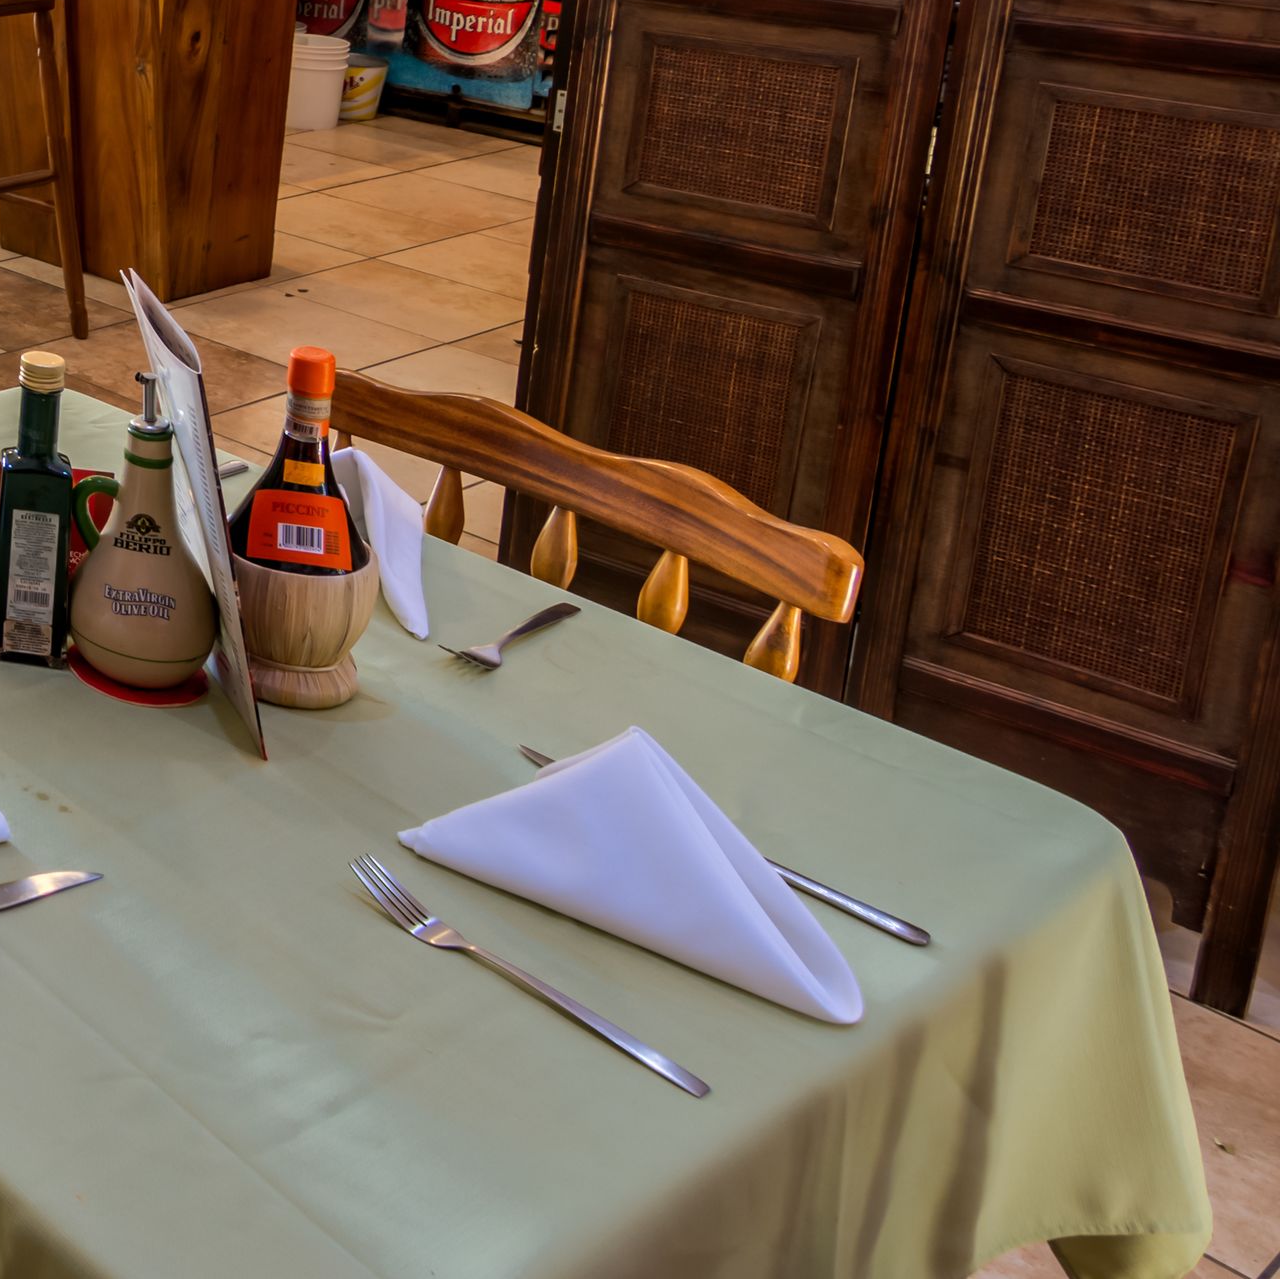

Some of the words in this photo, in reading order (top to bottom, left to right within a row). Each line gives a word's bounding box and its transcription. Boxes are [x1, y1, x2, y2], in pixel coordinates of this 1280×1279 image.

[271, 500, 329, 519] PICCINI
[113, 537, 173, 557] BERIO
[120, 532, 167, 546] FILIPPO
[112, 600, 148, 617] OLIVE
[148, 604, 171, 622] OIL
